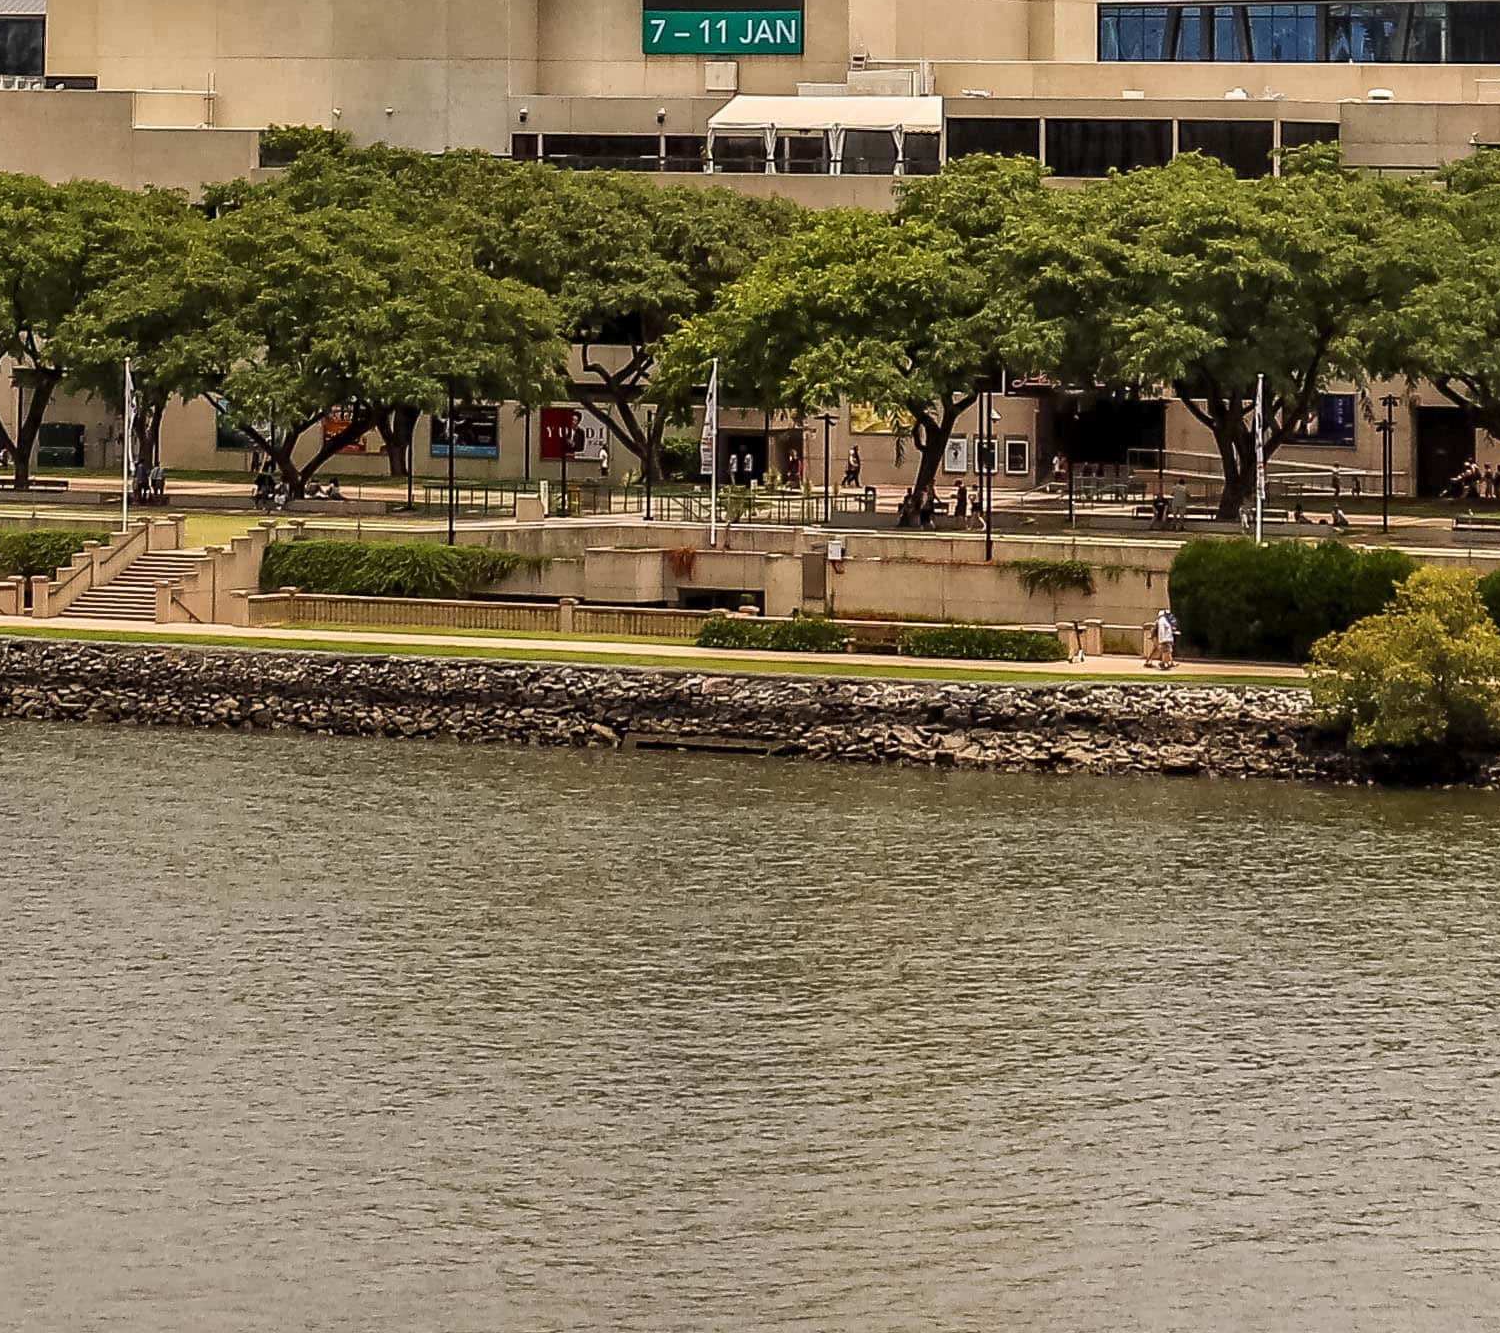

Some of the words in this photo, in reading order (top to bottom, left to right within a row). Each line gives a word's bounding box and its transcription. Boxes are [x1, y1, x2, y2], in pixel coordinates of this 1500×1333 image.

[650, 19, 665, 44] 7
[698, 19, 727, 44] 11
[739, 19, 797, 44] JAN
